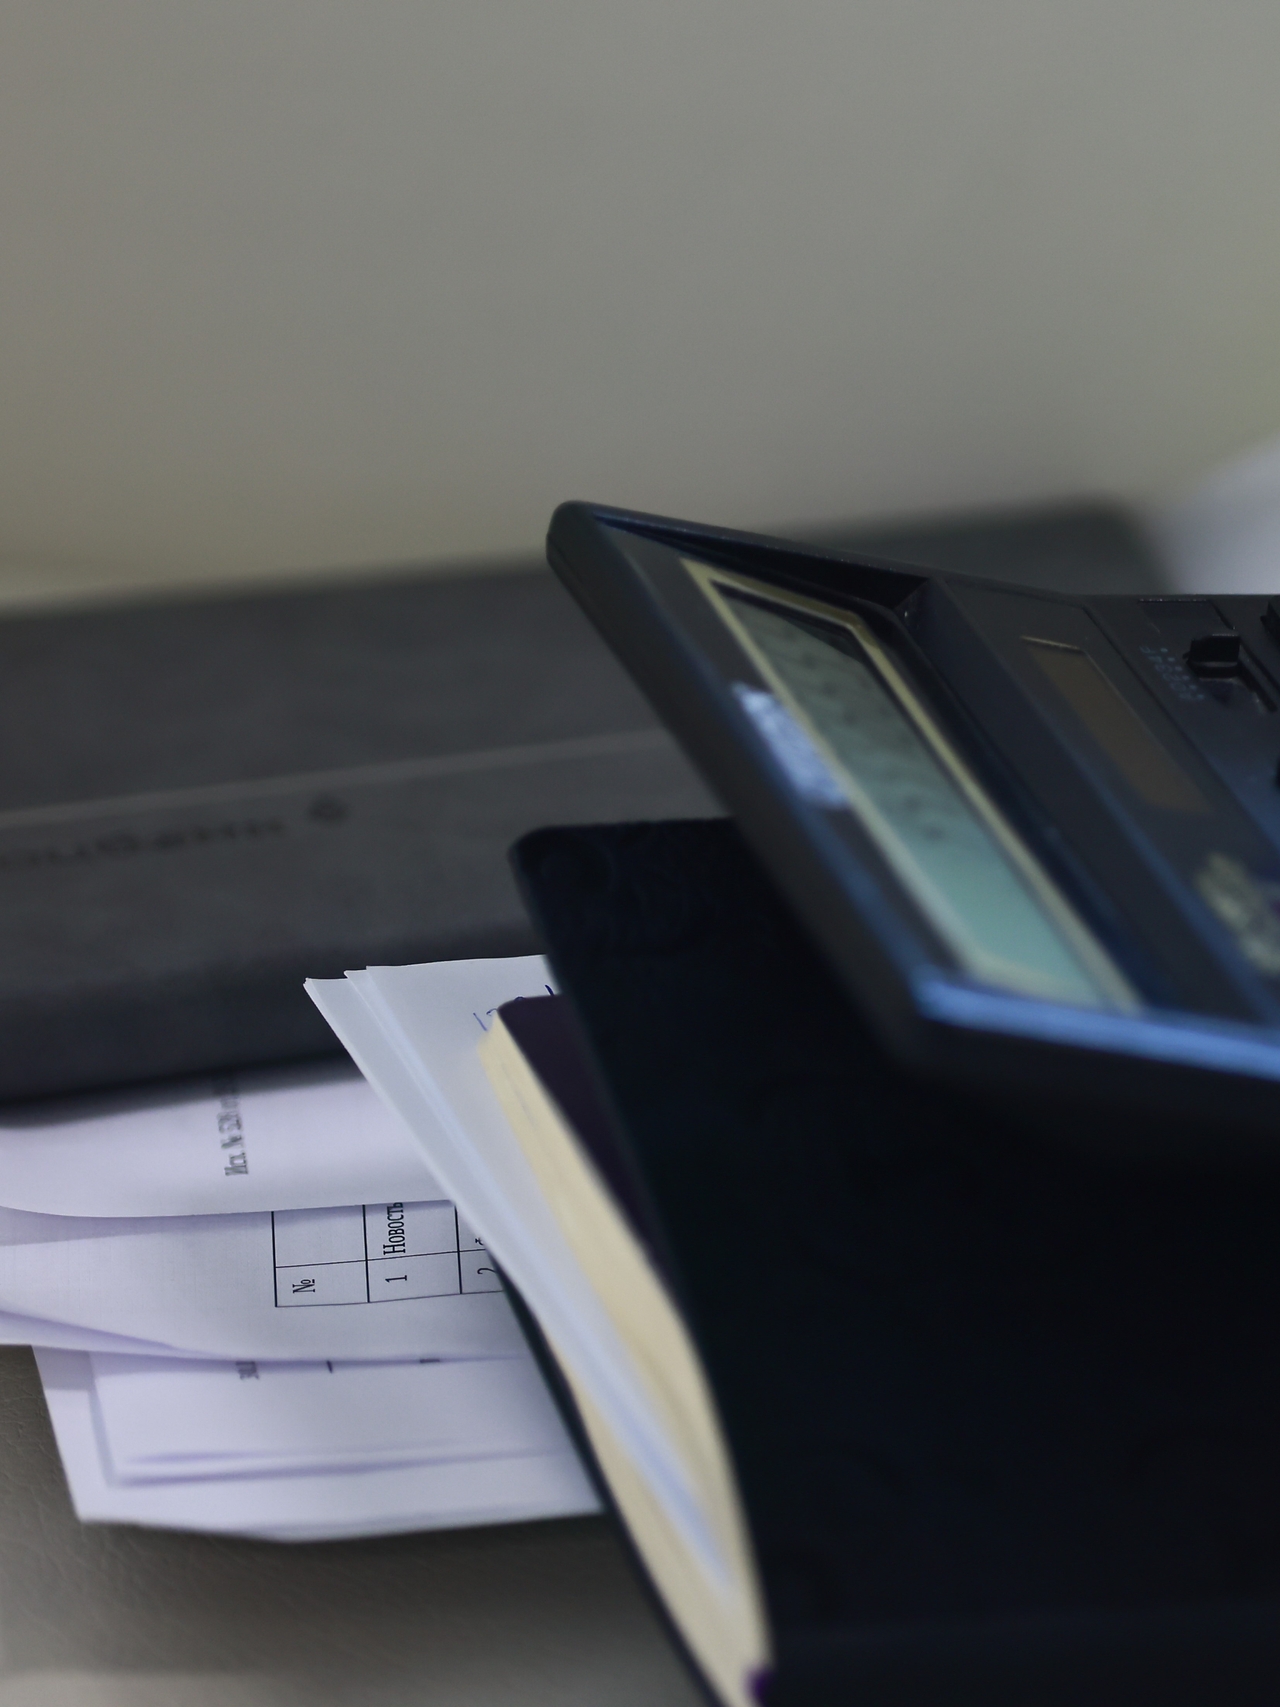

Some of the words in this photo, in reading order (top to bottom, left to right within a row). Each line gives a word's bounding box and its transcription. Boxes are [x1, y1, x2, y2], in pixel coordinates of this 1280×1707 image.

[383, 1202, 407, 1255] Новость
[384, 1274, 408, 1283] 1
[293, 1279, 316, 1294] №
